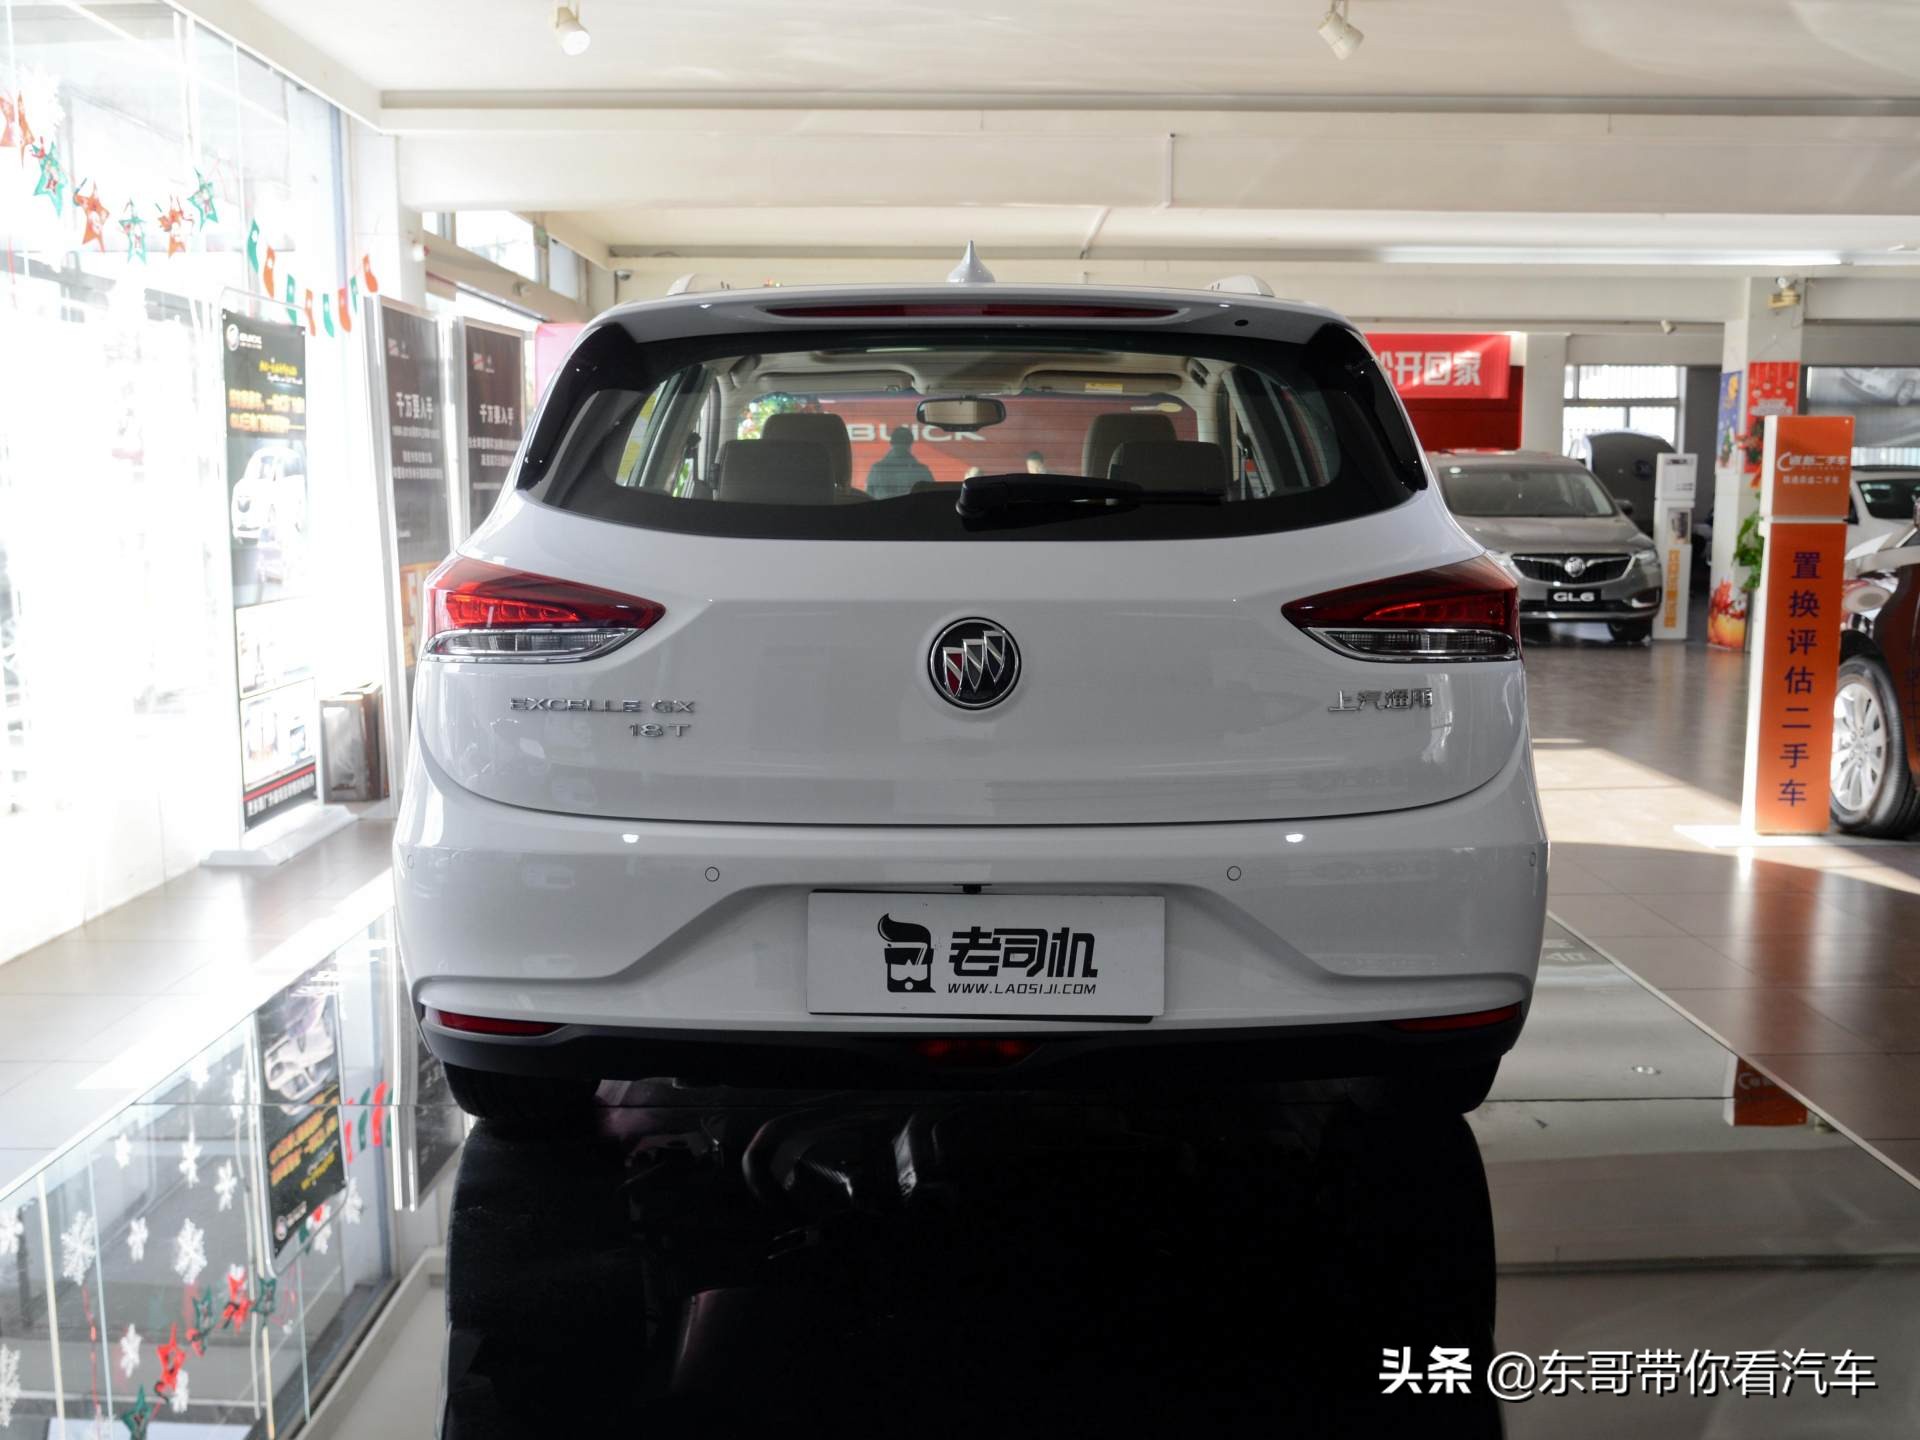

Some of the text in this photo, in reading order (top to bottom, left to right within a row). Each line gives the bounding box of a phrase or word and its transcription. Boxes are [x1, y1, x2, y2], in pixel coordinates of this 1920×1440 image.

[1778, 551, 1822, 807] 置换评估二手车
[510, 698, 696, 713] EXCELLE GX
[1328, 688, 1433, 712] 上汽通用
[949, 926, 1098, 977] 老司机
[947, 983, 1096, 995] WWW.LAOSIJI.COM
